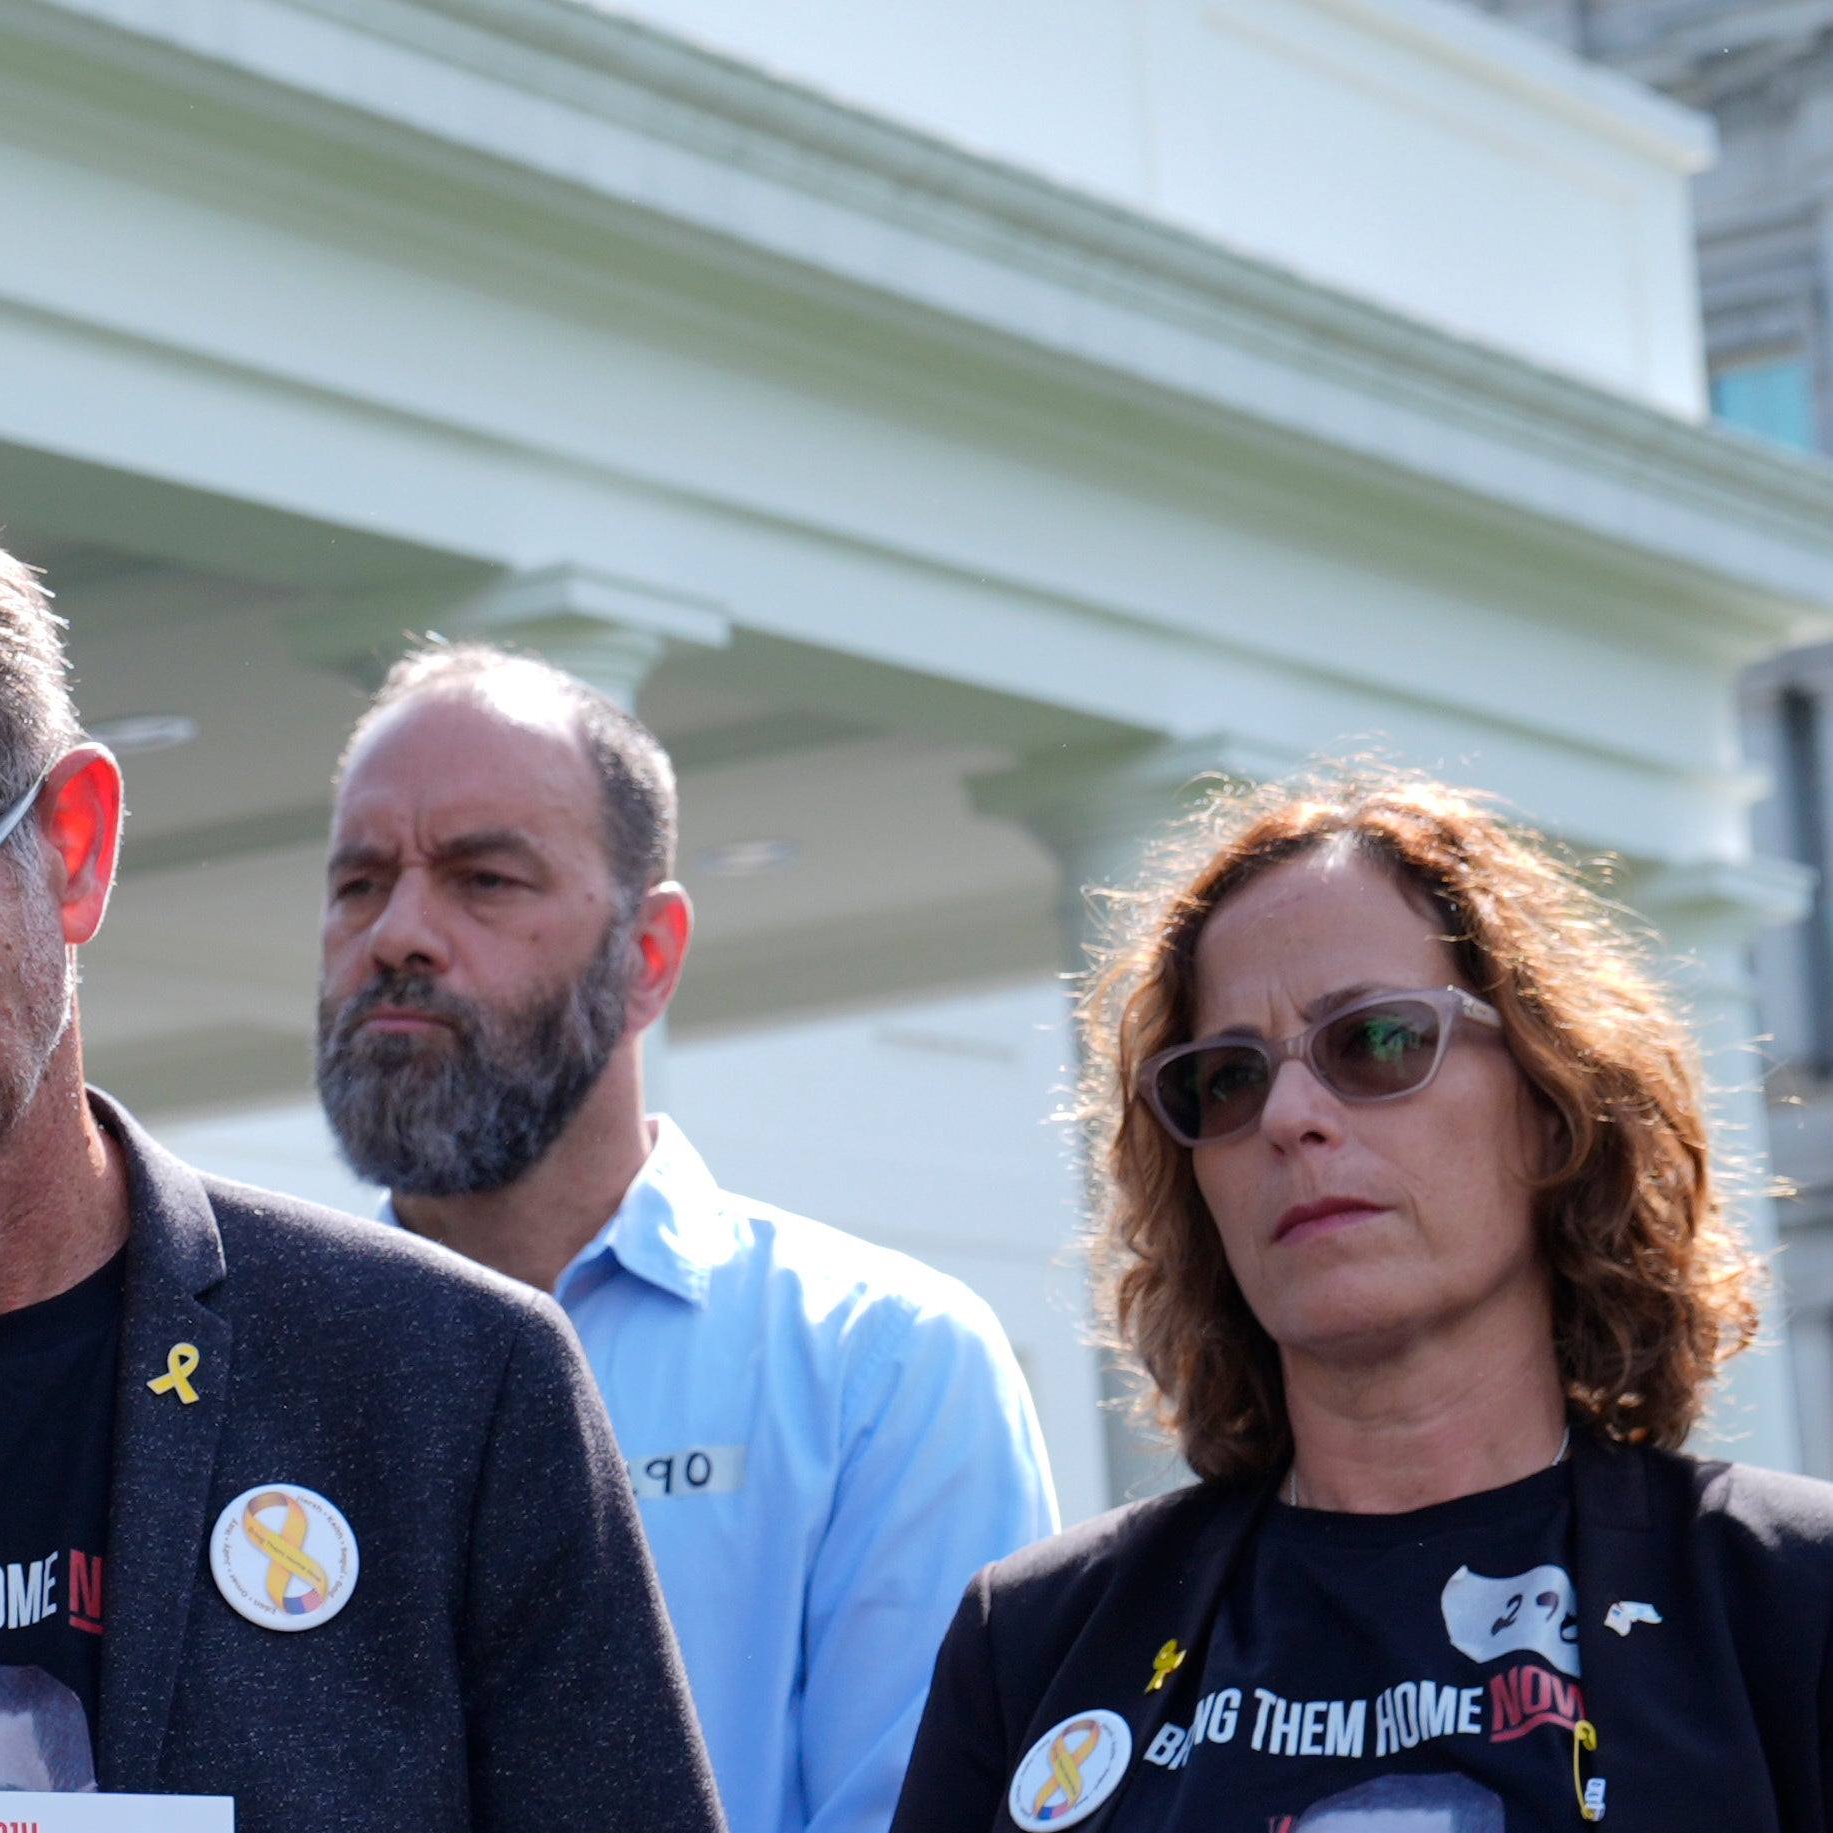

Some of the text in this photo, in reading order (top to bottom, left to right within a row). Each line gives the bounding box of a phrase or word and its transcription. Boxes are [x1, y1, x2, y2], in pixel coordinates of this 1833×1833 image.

[629, 1452, 712, 1494] 90
[1143, 1687, 1242, 1770] BNG
[1251, 1688, 1367, 1758] THEM
[1375, 1680, 1483, 1757] HOME
